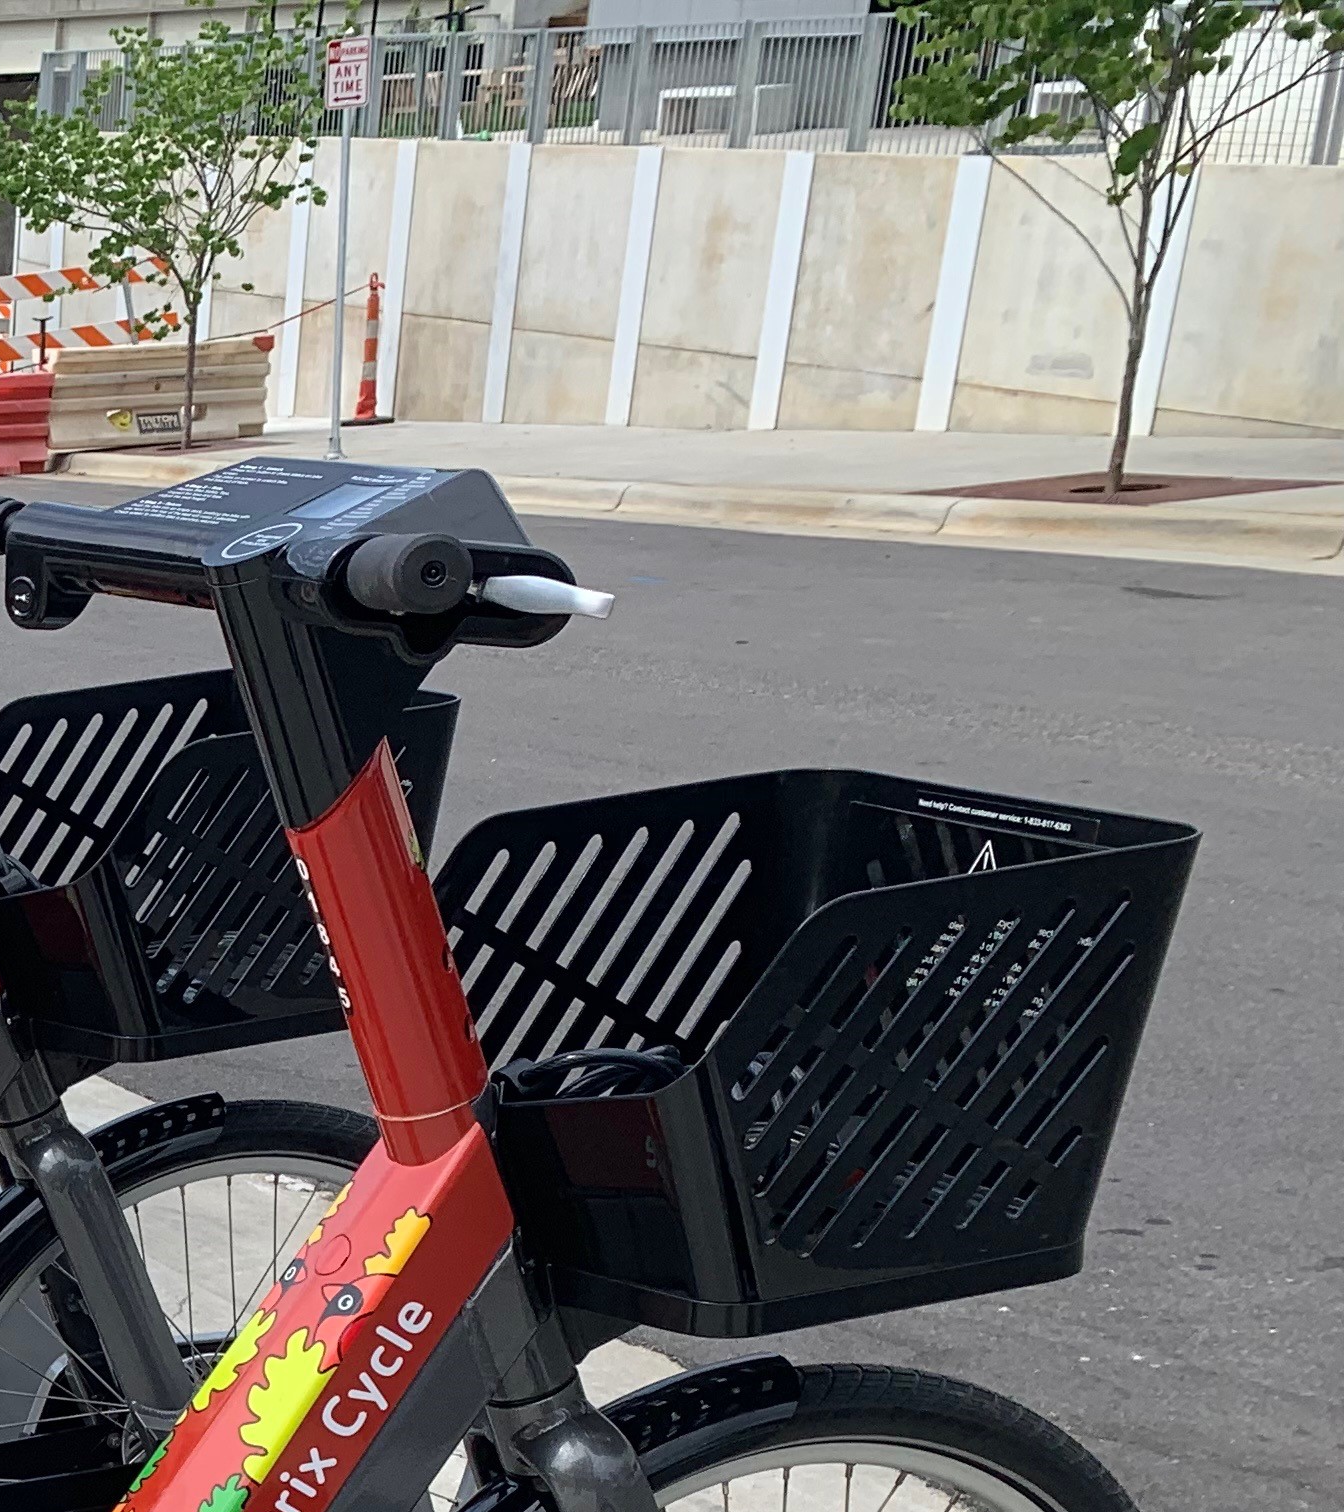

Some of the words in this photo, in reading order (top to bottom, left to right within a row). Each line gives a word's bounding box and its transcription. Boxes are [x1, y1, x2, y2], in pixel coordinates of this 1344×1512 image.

[332, 79, 362, 93] TIME
[335, 64, 361, 78] ANY
[295, 858, 351, 1009] 01845
[321, 1301, 433, 1437] Cycle
